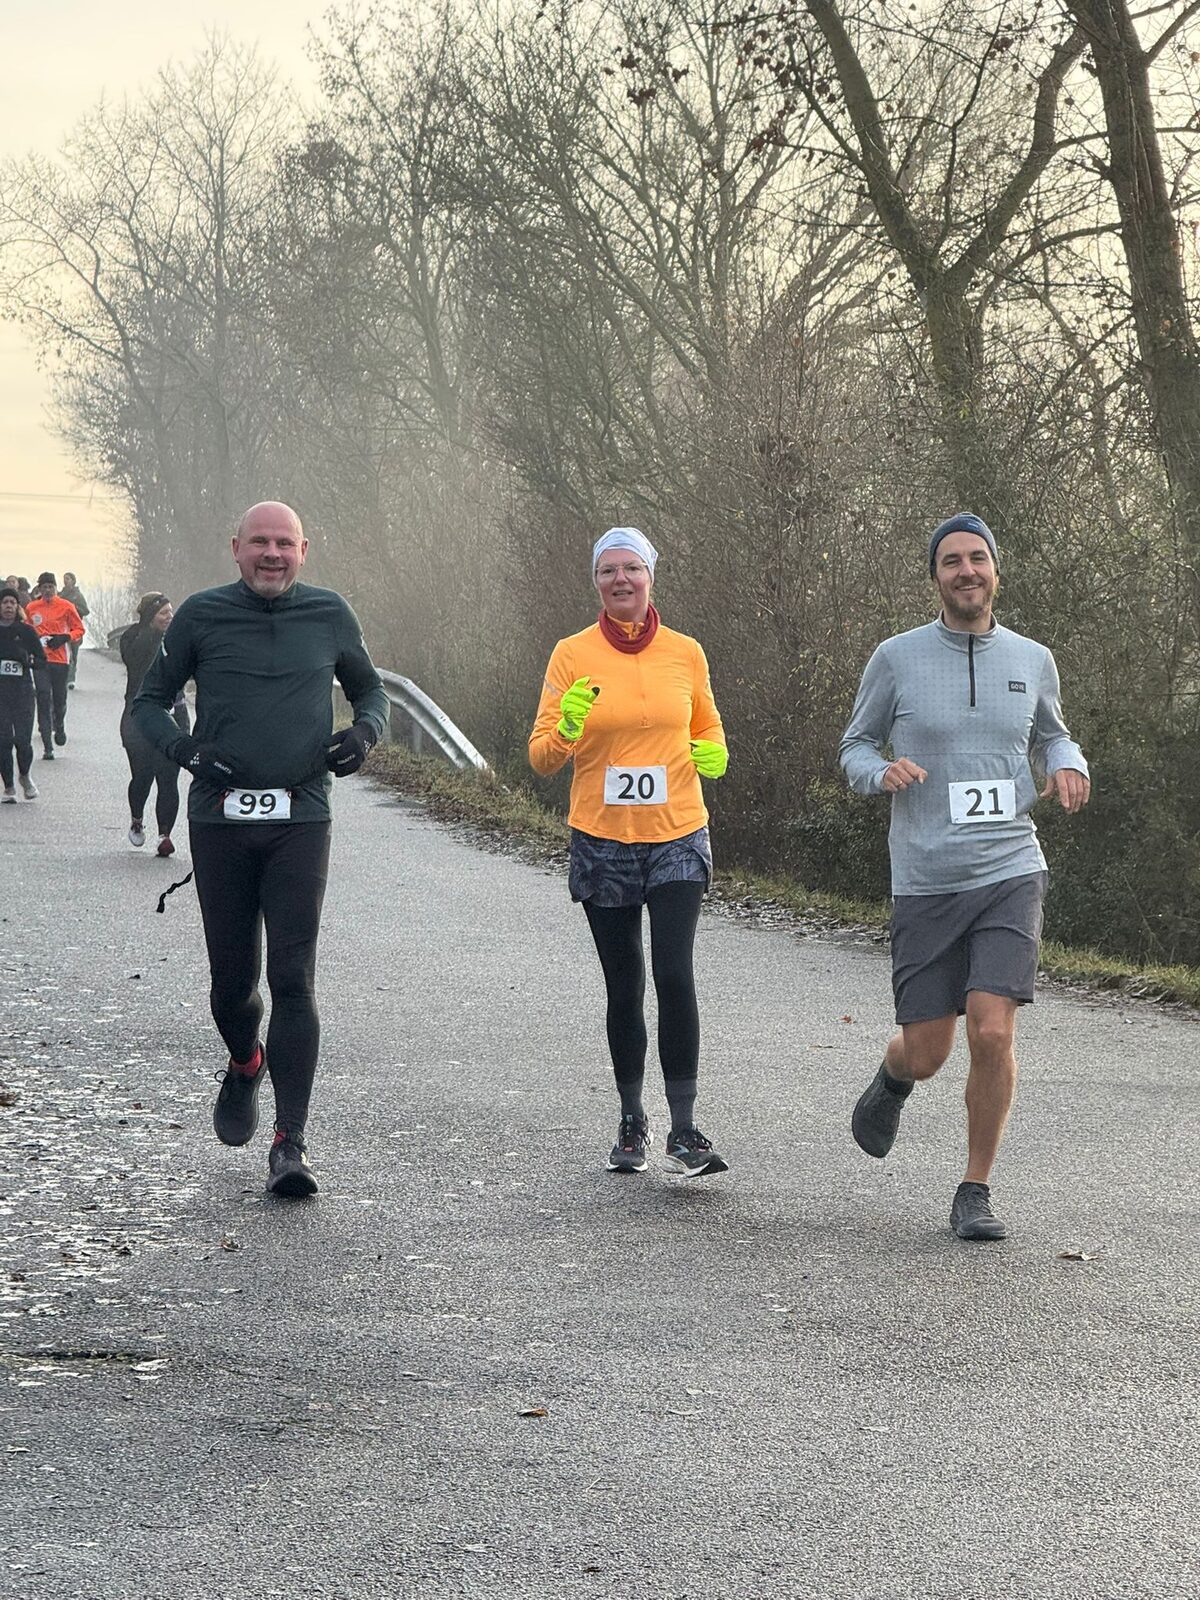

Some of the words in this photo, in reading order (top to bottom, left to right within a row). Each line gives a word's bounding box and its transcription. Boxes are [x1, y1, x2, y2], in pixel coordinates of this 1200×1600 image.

[5, 662, 18, 673] 85
[618, 773, 654, 799] 20
[239, 793, 276, 815] 99
[965, 788, 1003, 816] 21
